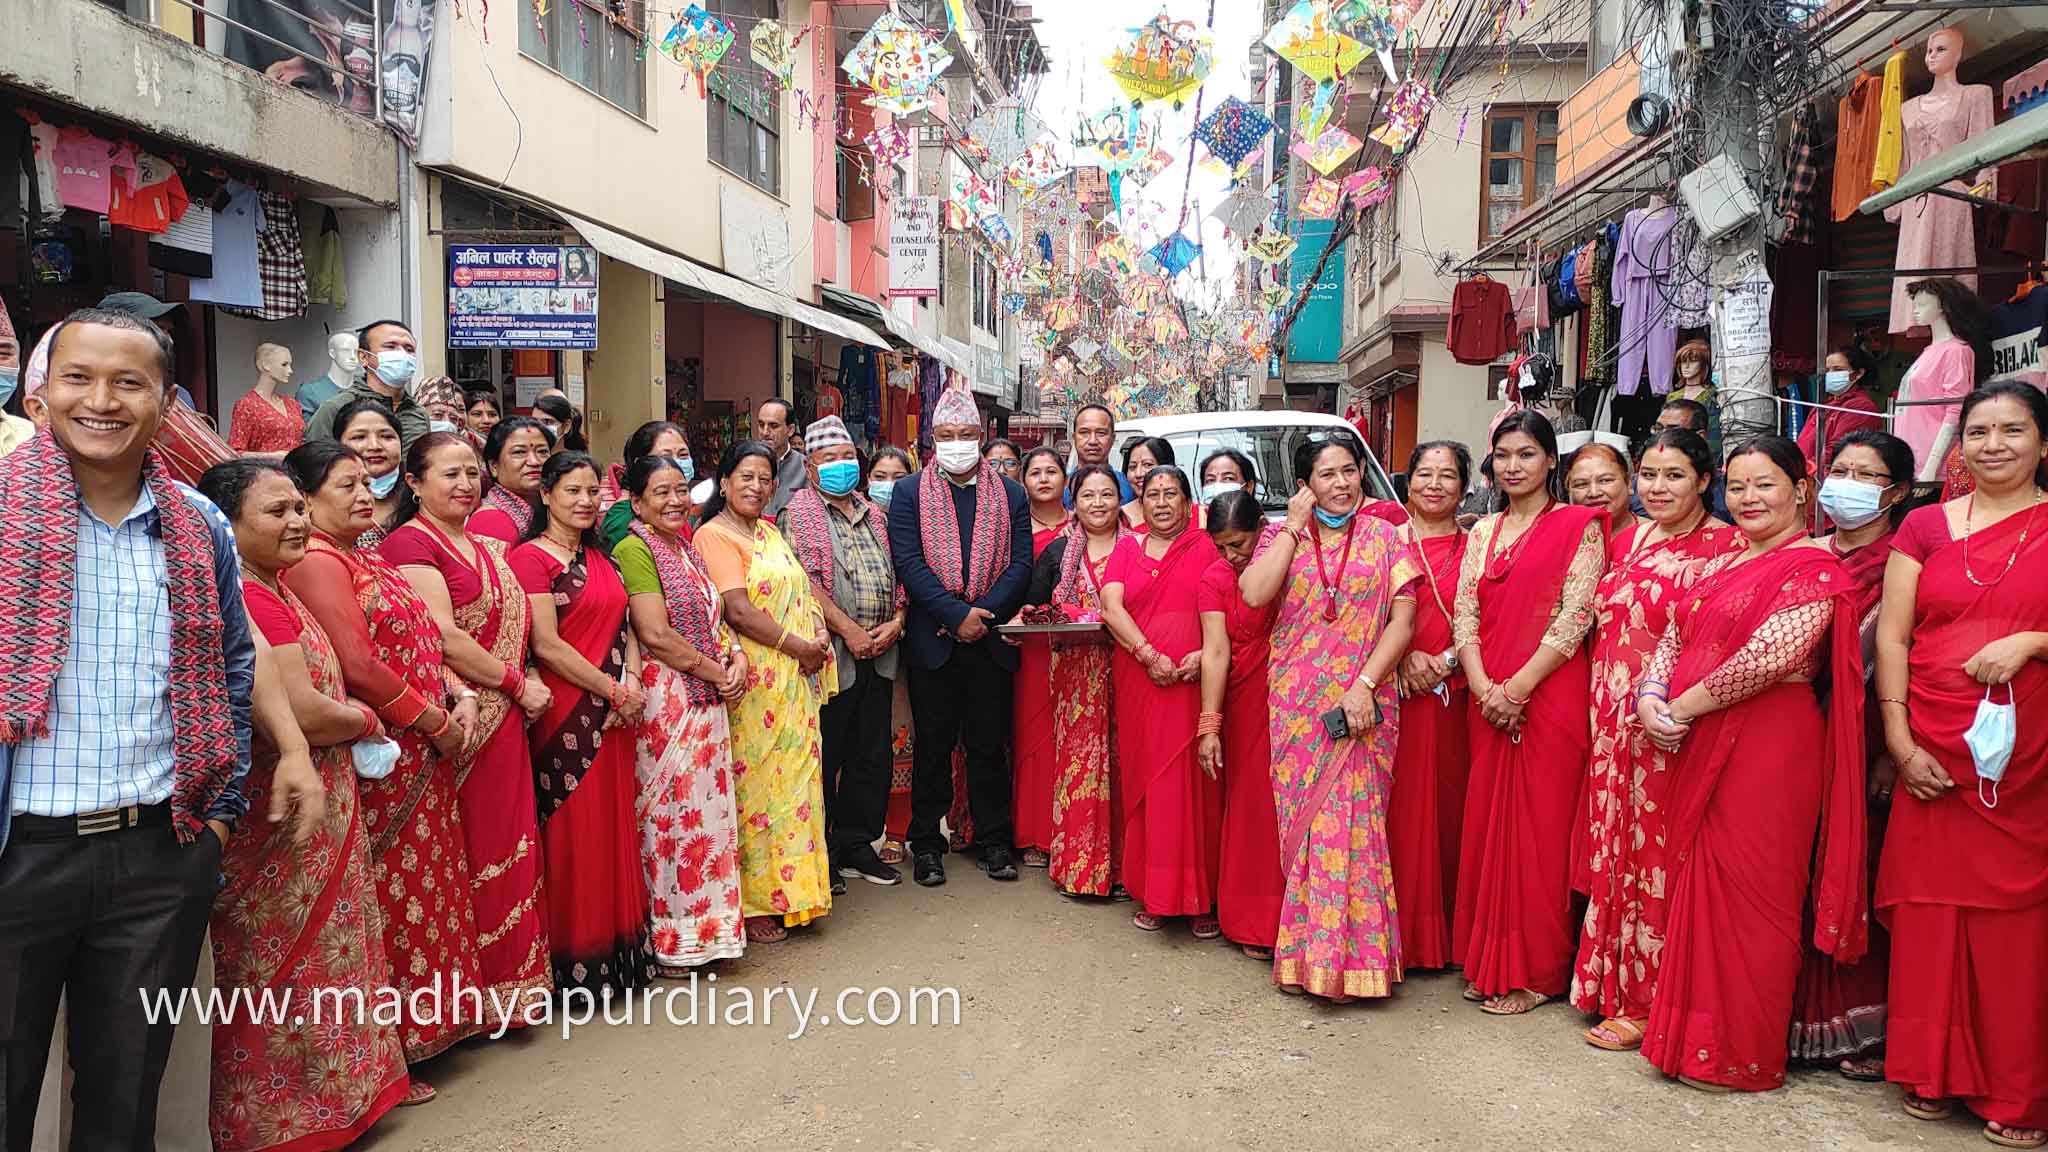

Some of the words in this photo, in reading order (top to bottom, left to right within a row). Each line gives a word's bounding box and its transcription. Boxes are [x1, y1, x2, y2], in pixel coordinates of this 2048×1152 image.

[906, 223, 921, 231] AND
[891, 236, 936, 245] COUNSELING
[455, 248, 490, 265] अनिल
[899, 248, 927, 257] CENTER
